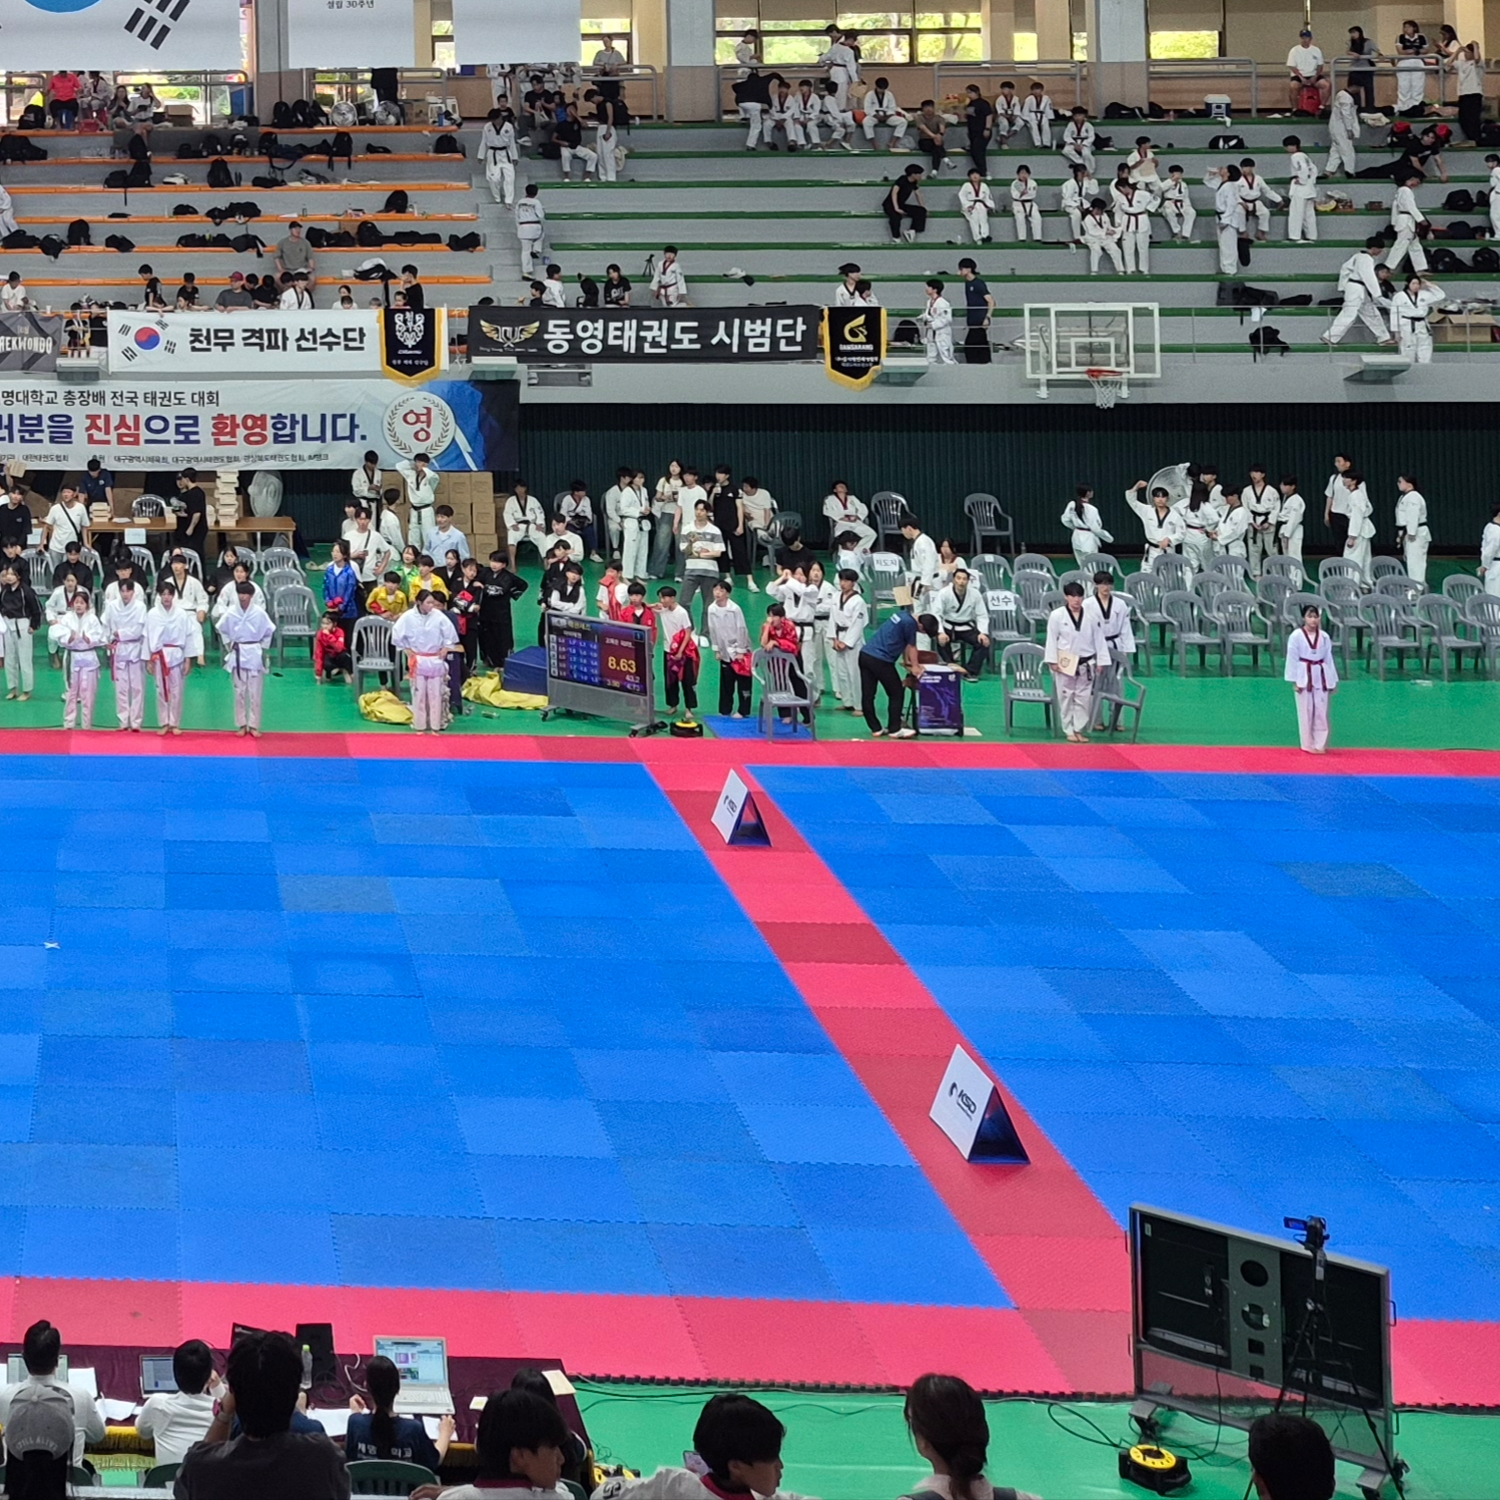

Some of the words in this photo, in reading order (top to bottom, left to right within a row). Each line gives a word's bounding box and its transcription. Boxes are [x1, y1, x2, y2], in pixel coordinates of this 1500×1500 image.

[188, 327, 235, 352] 천무
[241, 328, 289, 352] 격파
[295, 327, 366, 352] 선수단
[543, 318, 702, 355] 동영태권도
[710, 316, 807, 354] 시범단
[62, 390, 106, 407] 총장배
[110, 390, 140, 408] 전국
[143, 390, 188, 407] 태권도
[191, 390, 220, 407] 대회
[84, 413, 201, 447] 진심으로
[211, 412, 368, 447] 환영합니다.
[402, 406, 432, 443] 영
[991, 595, 1012, 607] 선수
[607, 655, 637, 674] 8.63
